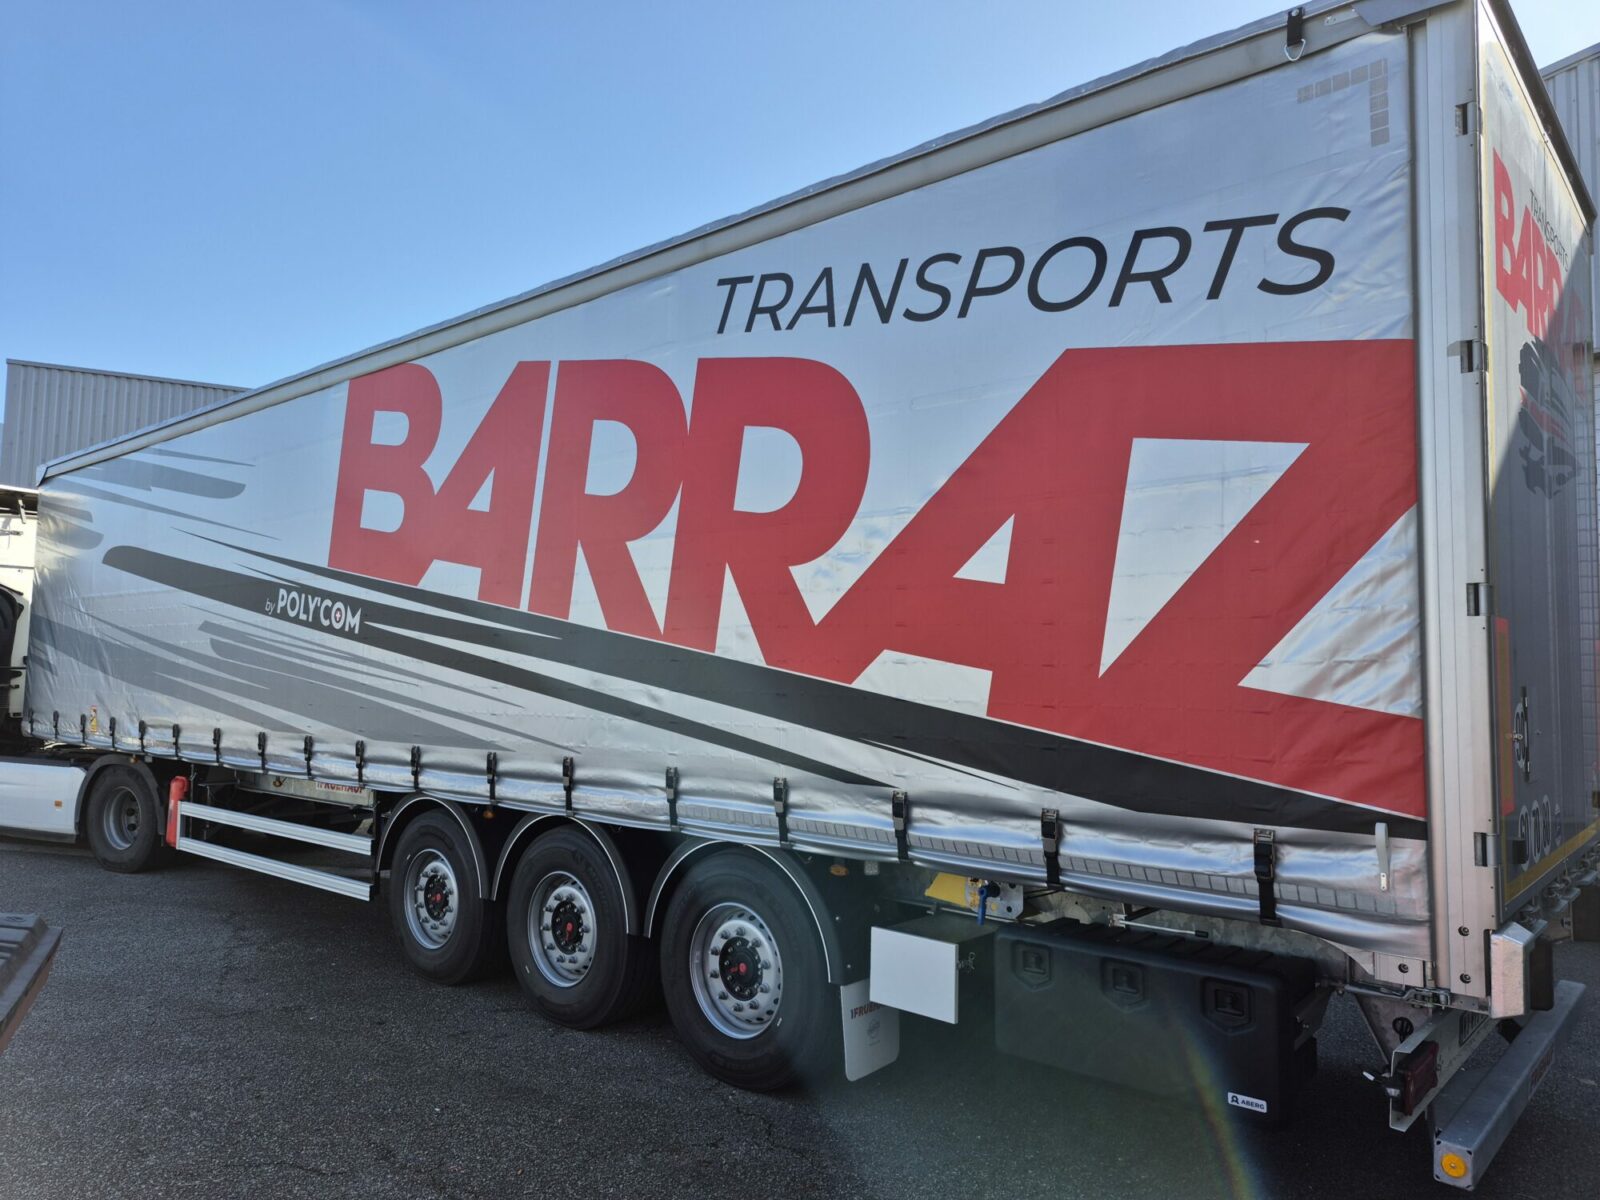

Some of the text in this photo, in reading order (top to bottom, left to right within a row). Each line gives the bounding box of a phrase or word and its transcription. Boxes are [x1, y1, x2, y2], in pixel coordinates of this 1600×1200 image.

[715, 206, 1351, 334] TRANSPORTS
[1529, 188, 1569, 271] TRANSPORTS
[265, 598, 275, 615] by
[328, 339, 1426, 822] BARRAZ
[1241, 1100, 1265, 1110] ABERG
